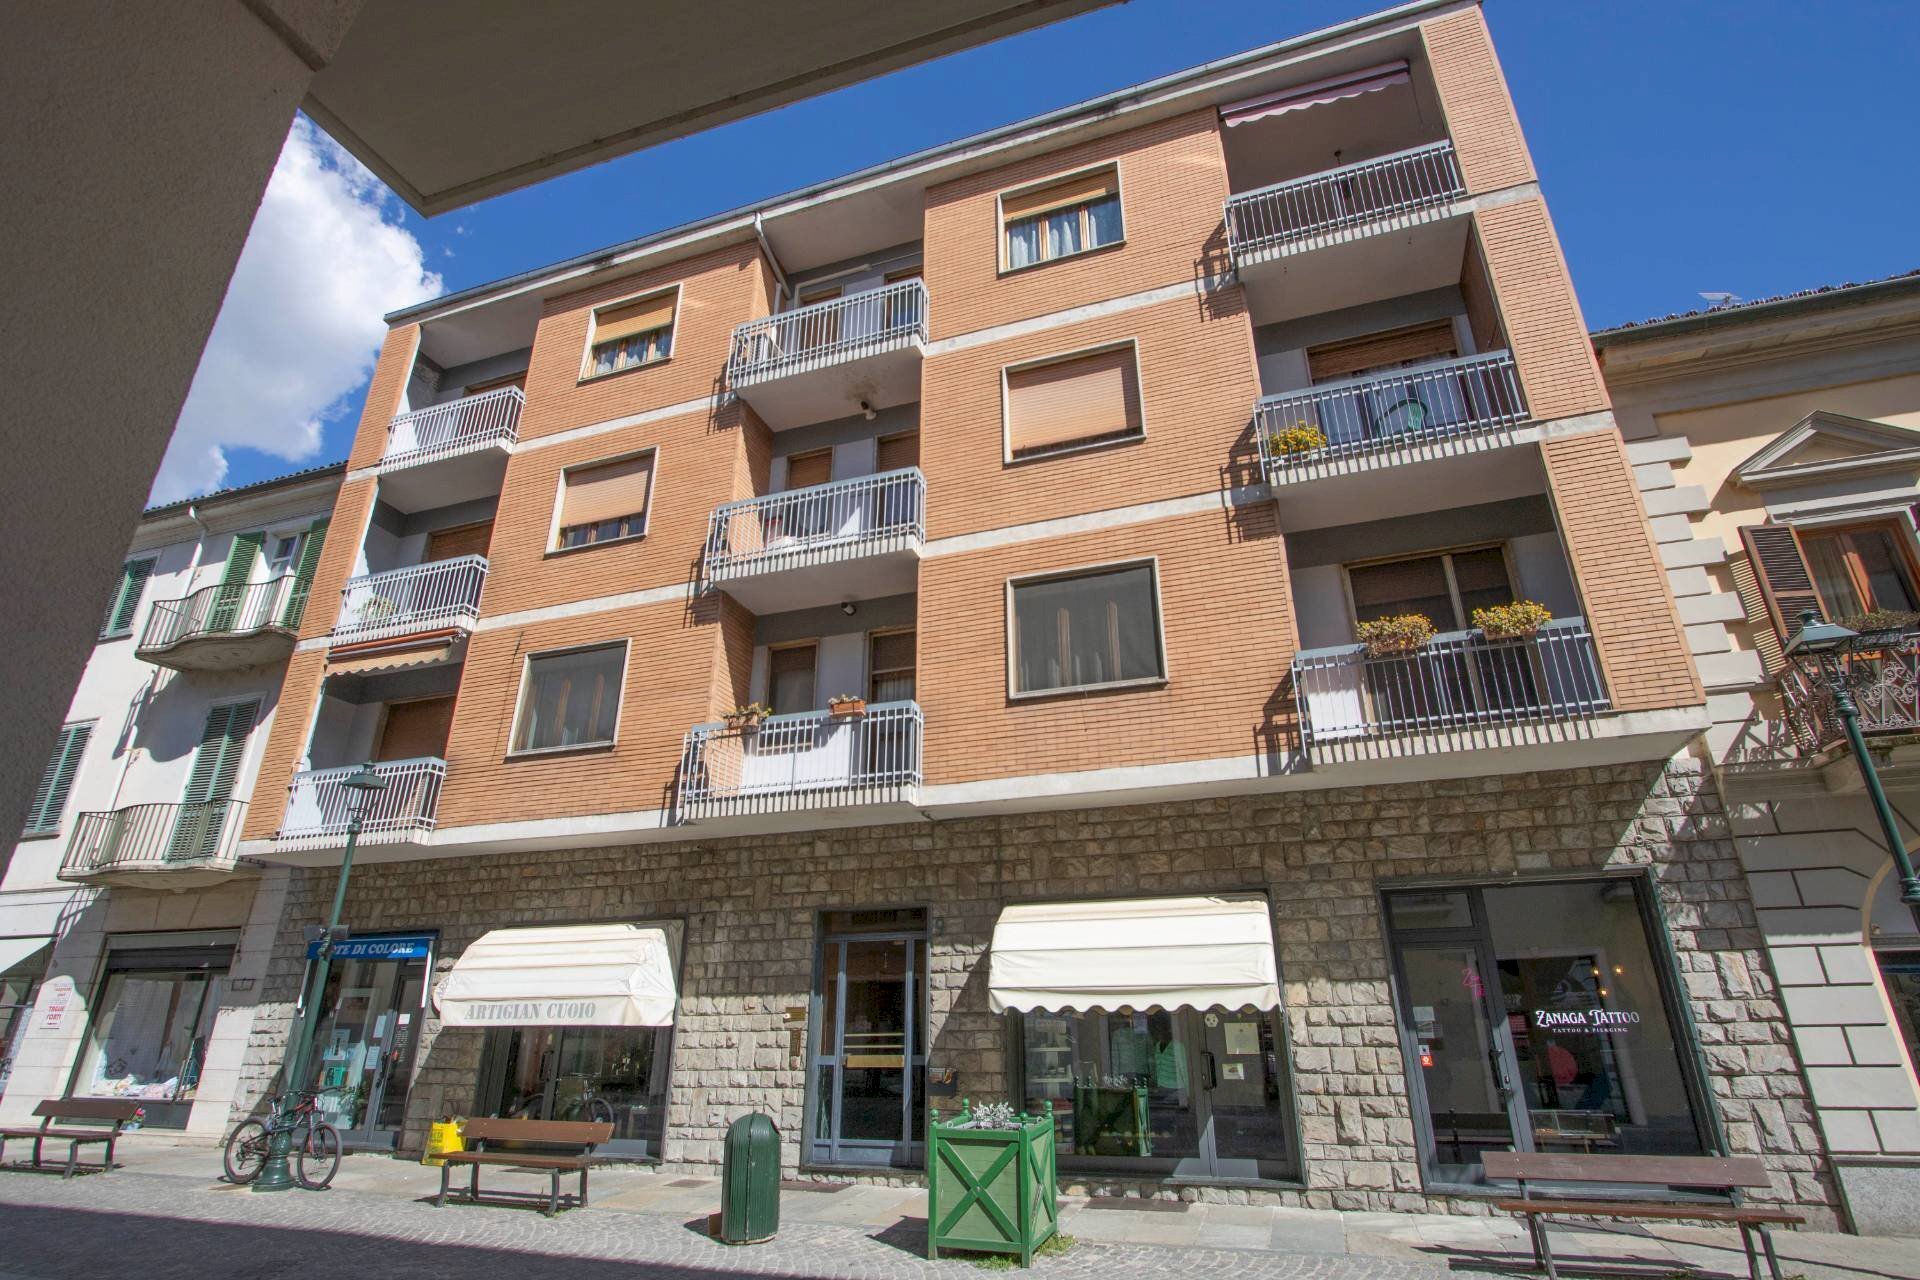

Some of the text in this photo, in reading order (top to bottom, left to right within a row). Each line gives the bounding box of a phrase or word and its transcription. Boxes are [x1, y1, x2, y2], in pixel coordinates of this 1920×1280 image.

[352, 943, 368, 954] DI
[368, 942, 415, 954] COLORE
[464, 1002, 597, 1020] ARTIGIAN CUOIO
[1535, 1009, 1640, 1028] ZANAGA TATTOO
